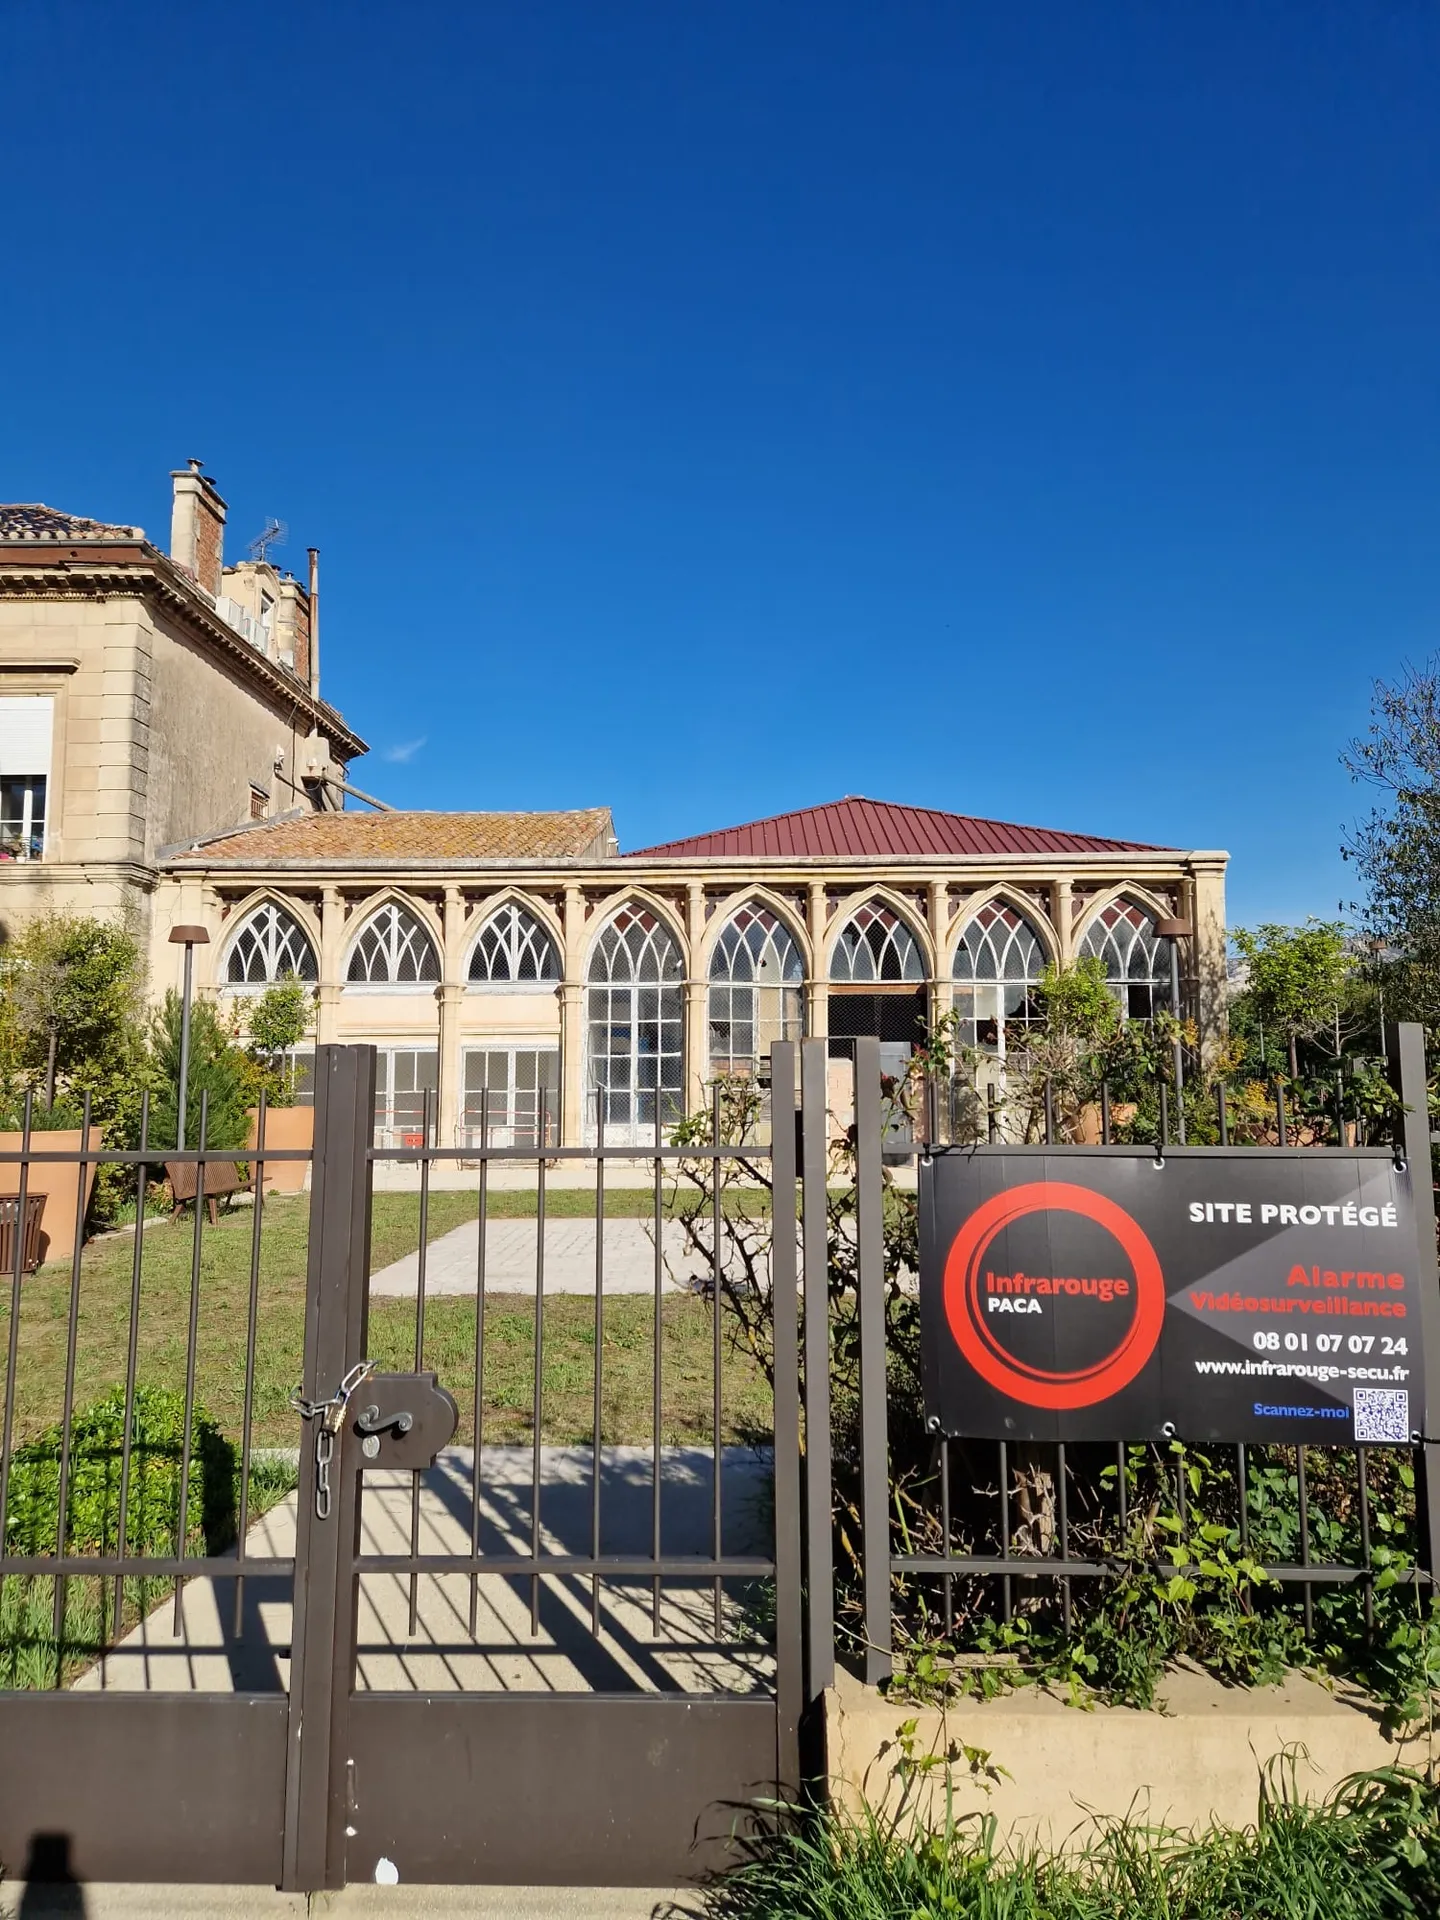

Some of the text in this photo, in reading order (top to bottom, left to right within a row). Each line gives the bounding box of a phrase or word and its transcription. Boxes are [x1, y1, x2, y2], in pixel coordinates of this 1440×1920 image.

[1189, 1201, 1398, 1227] SITE PROTÉGÉ
[986, 1272, 1129, 1302] Infrarouge
[1287, 1264, 1405, 1291] Alarme
[988, 1297, 1042, 1314] PACA
[1189, 1291, 1407, 1318] Vidéosurveillance
[1253, 1331, 1409, 1356] 08 01 07 07 24
[1195, 1359, 1410, 1382] www.infrarouge-secu.fr
[1253, 1403, 1350, 1419] Scannez-moi
